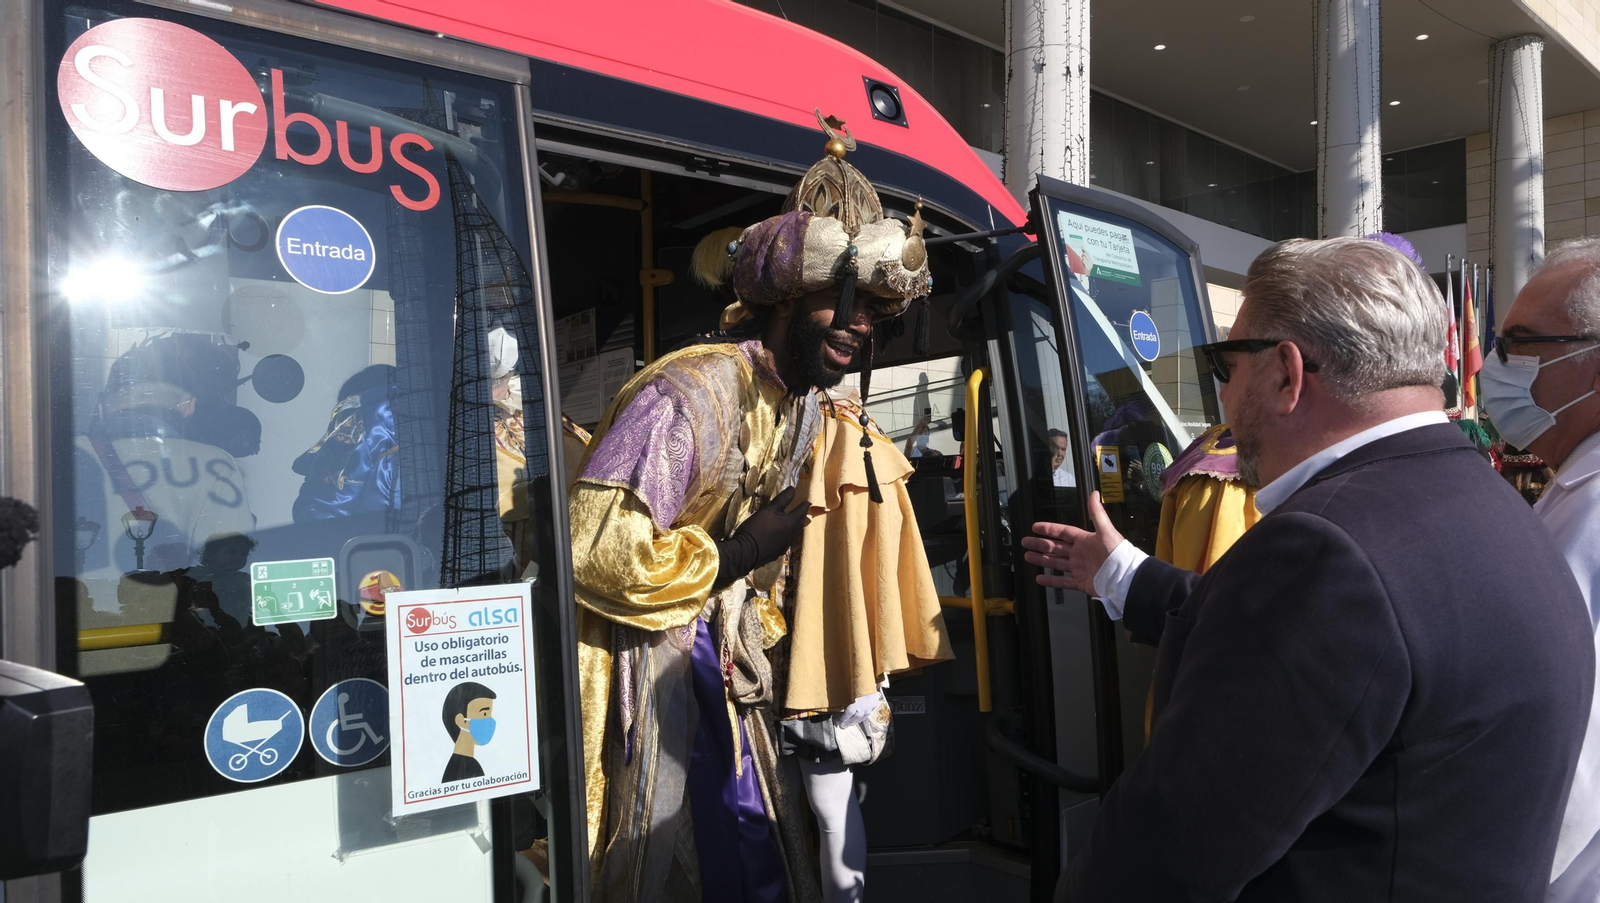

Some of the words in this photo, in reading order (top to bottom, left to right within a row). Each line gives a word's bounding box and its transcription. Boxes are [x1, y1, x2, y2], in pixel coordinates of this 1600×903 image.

[70, 45, 440, 211] Surbus
[1085, 225, 1109, 237] puedes
[286, 238, 366, 262] Entrada
[1087, 237, 1100, 247] con
[1101, 240, 1108, 249] tu
[1108, 241, 1131, 254] Tarjeta
[1133, 330, 1157, 342] Entrada
[406, 610, 457, 630] Surbús
[468, 606, 518, 627] alsa
[414, 640, 439, 653] Uso
[441, 634, 509, 651] obligatorio
[420, 655, 437, 668] de
[439, 649, 507, 666] mascarillas
[404, 671, 447, 686] dentro
[449, 665, 469, 680] del
[471, 662, 523, 677] autobús.
[408, 786, 442, 799] Gracias
[443, 784, 460, 795] por
[461, 782, 471, 790] tu
[472, 771, 528, 788] colaboración
